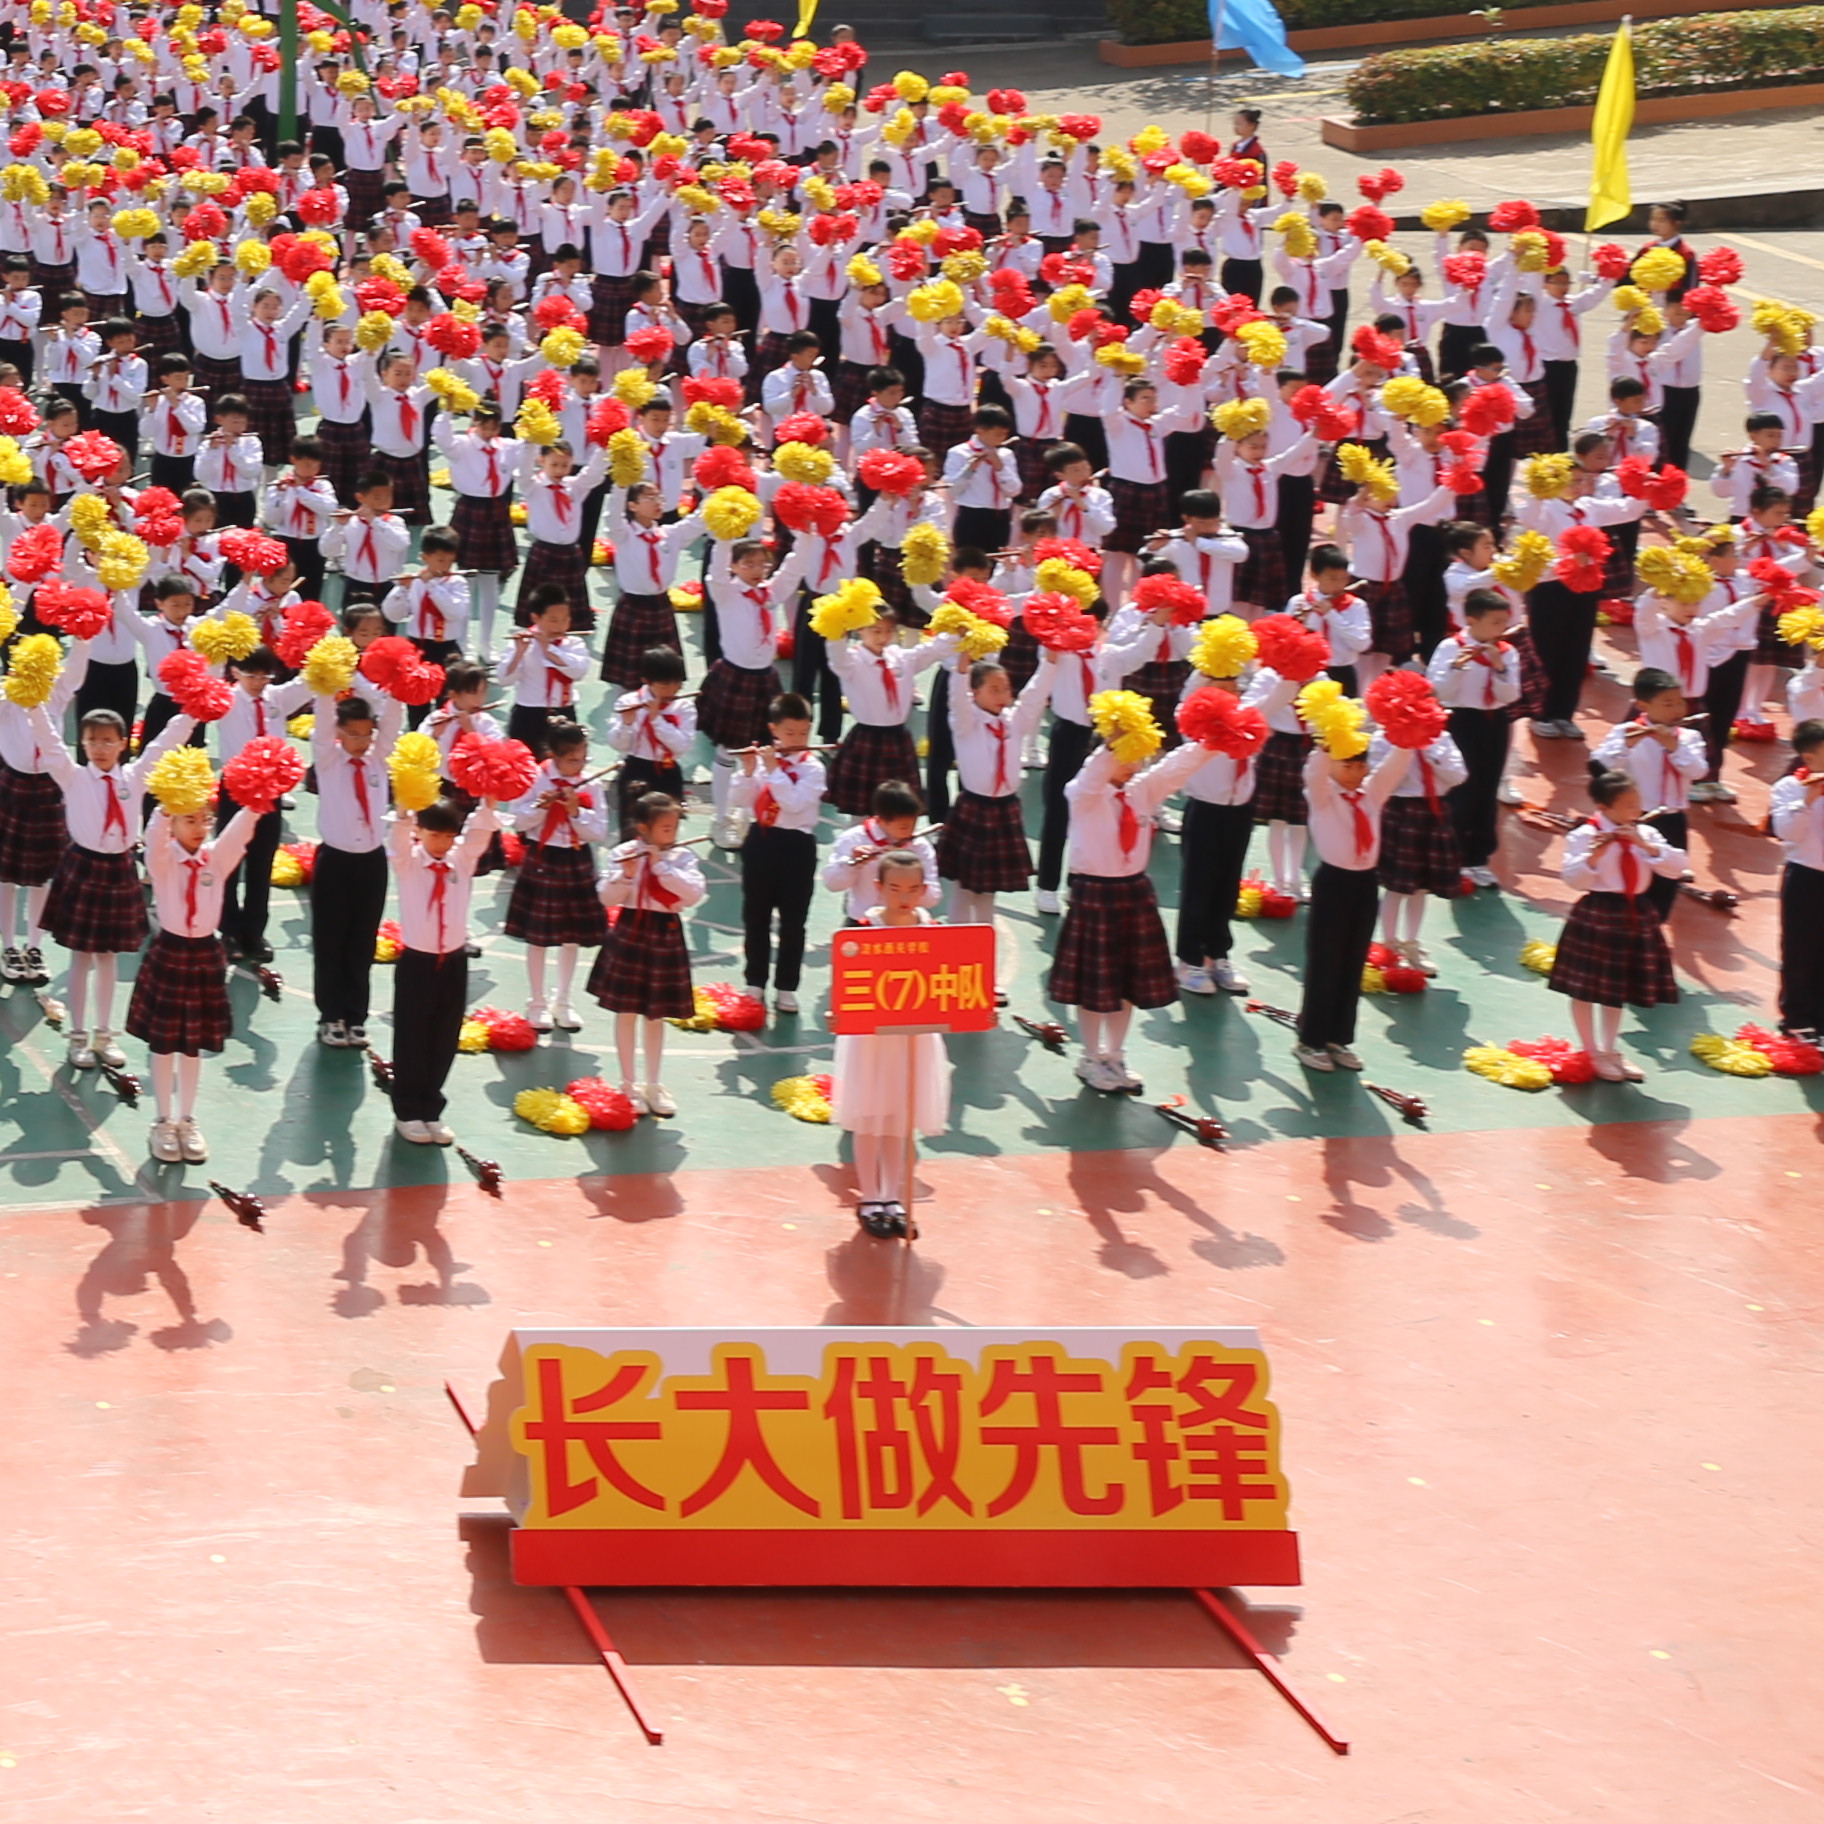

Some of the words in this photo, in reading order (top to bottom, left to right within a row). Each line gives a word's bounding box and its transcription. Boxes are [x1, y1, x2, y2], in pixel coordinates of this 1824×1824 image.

[840, 963, 989, 1012] 三(7)中队
[523, 1354, 1279, 1522] 长大做先锋
